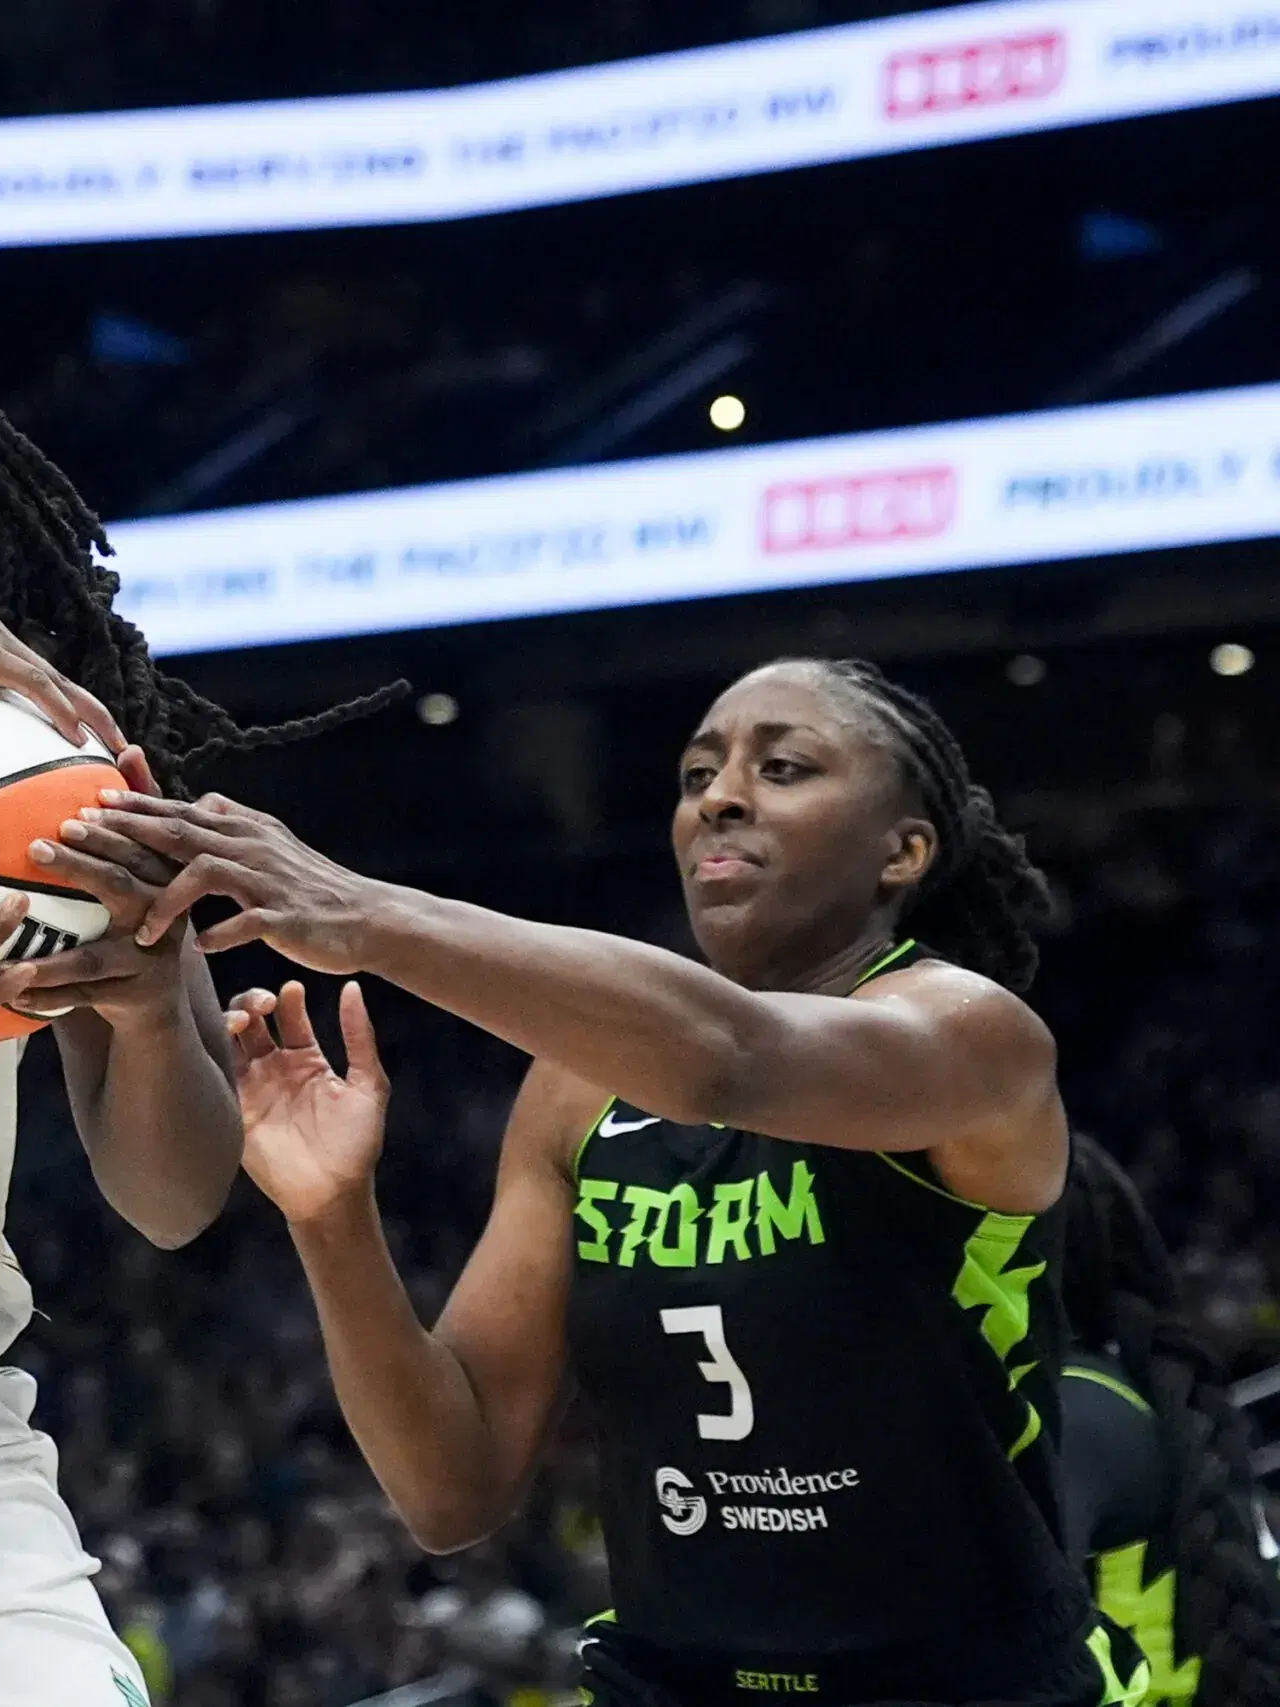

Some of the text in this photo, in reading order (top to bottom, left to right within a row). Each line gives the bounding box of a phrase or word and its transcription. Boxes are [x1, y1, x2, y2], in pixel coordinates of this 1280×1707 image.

[574, 1160, 825, 1268] STORM
[659, 1304, 755, 1442] 3
[705, 1467, 860, 1495] Providence
[721, 1506, 828, 1532] SWEDISH
[735, 1670, 820, 1692] SEATTLE
